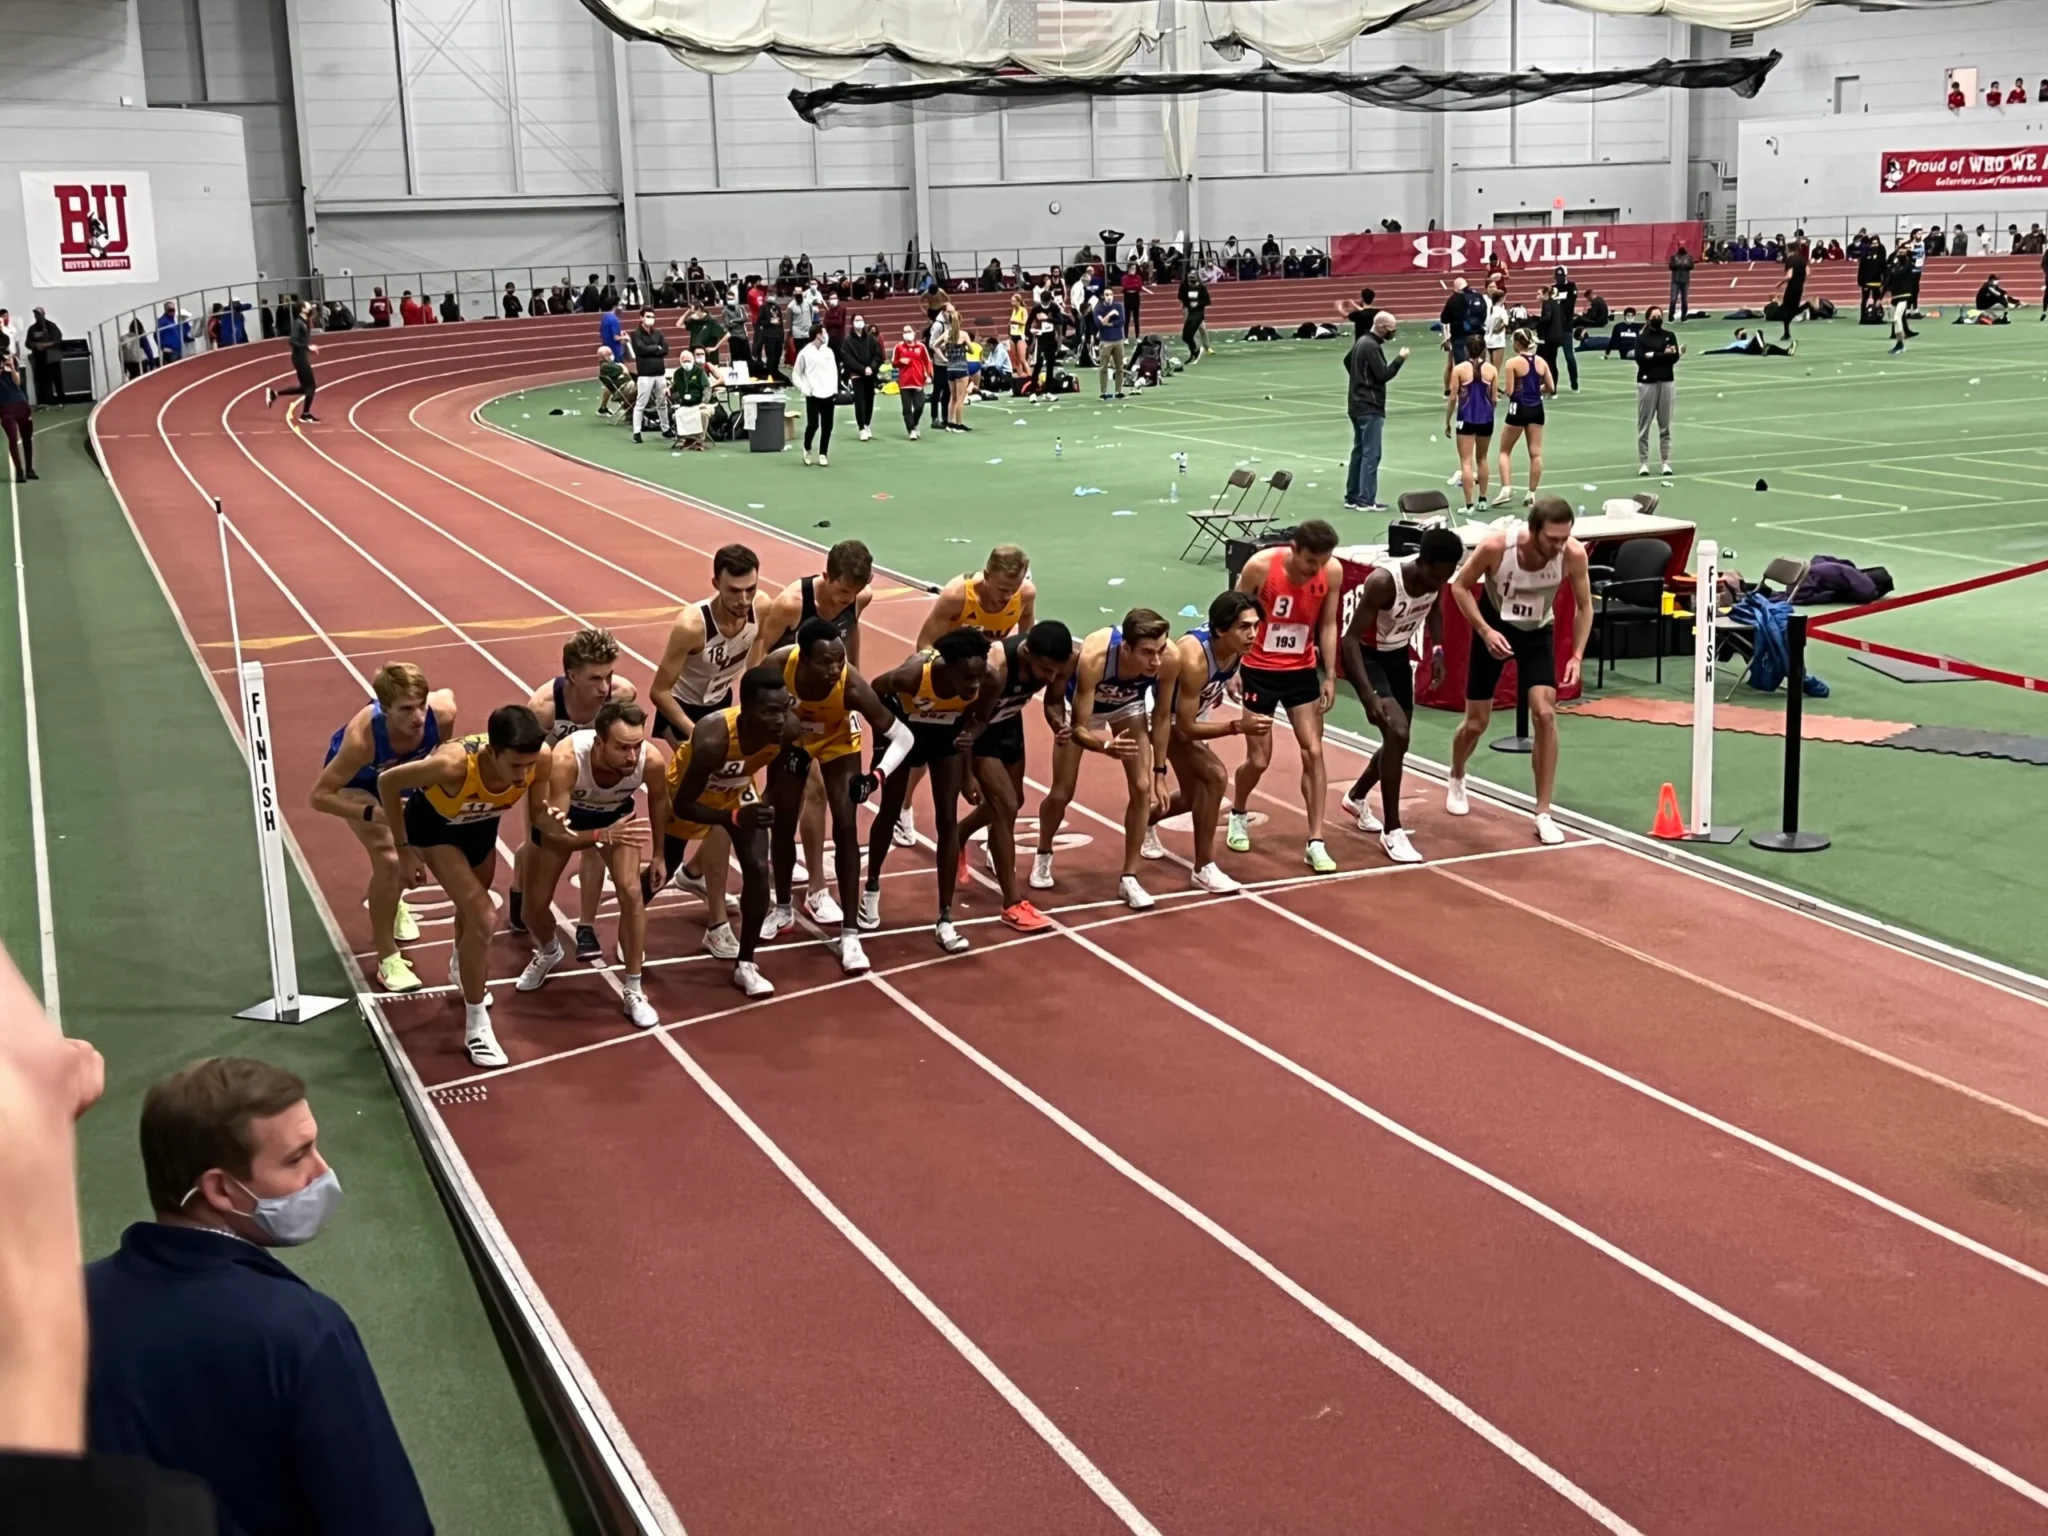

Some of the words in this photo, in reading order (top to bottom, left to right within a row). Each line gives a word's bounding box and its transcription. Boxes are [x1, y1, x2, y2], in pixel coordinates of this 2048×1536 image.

[1907, 157, 1947, 173] Proud
[1950, 156, 1965, 174] of
[1969, 156, 2004, 173] WHO
[2010, 153, 2036, 171] WE
[54, 185, 128, 254] BU
[1479, 235, 1497, 263] I
[1500, 231, 1616, 263] WILL.
[1275, 596, 1290, 617] 3
[1395, 601, 1407, 618] 2
[1705, 565, 1715, 682] FINISH
[1275, 635, 1296, 648] 193
[708, 646, 724, 665] 18
[251, 692, 276, 831] FINISH
[468, 803, 486, 812] 11
